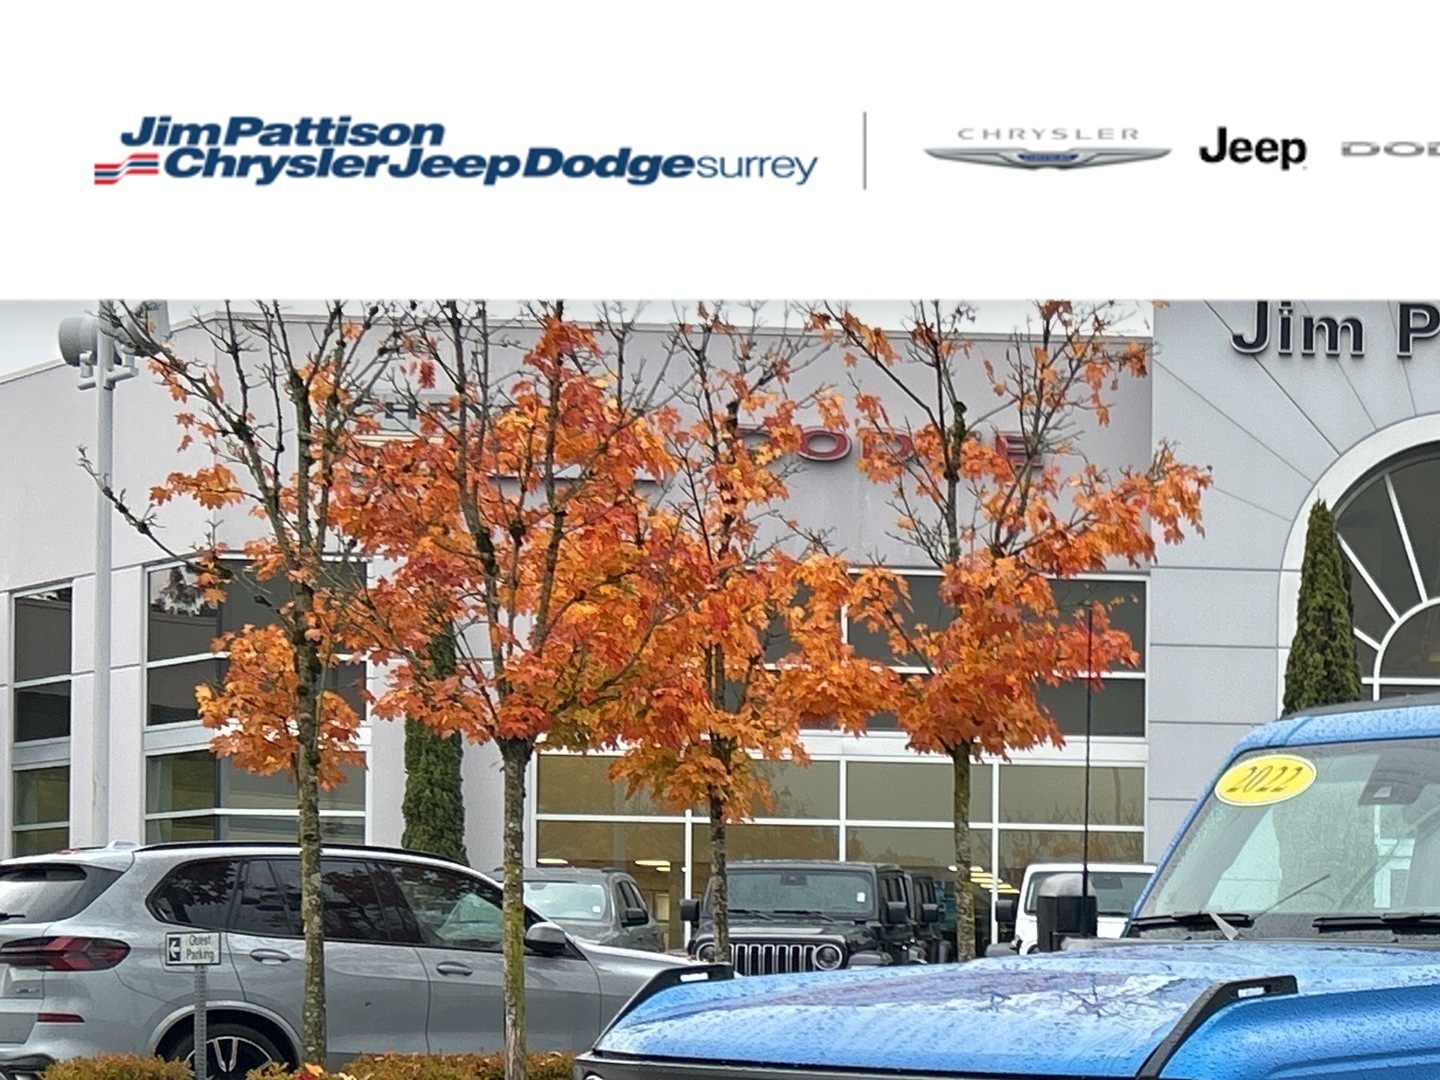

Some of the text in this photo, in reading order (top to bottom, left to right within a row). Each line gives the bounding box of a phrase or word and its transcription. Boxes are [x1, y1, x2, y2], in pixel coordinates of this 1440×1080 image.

[1231, 301, 1366, 357] Jim
[1226, 765, 1304, 793] 2022
[186, 949, 215, 963] Parking
